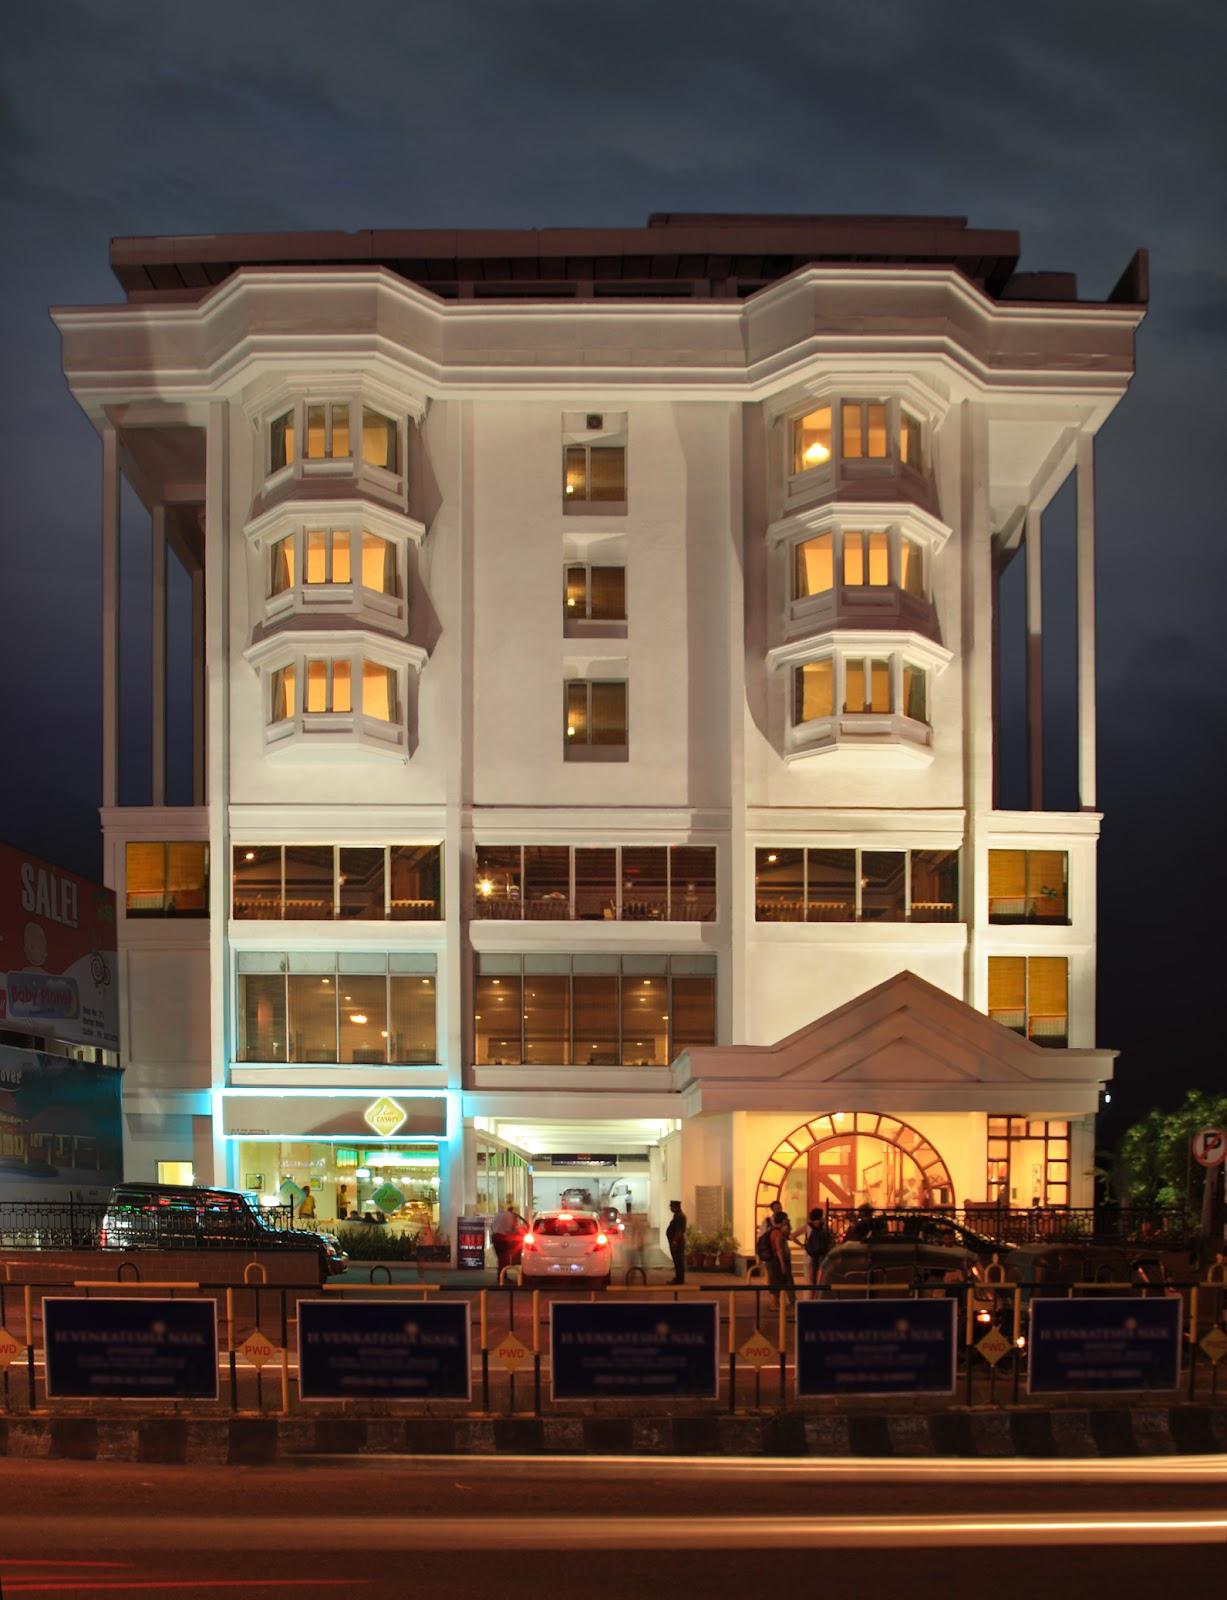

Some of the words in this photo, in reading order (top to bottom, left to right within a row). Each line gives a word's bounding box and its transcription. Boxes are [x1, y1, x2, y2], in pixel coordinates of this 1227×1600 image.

[21, 862, 79, 928] SALE!
[245, 1345, 271, 1356] PWD
[499, 1348, 525, 1358] PWD
[745, 1347, 769, 1357] PWD
